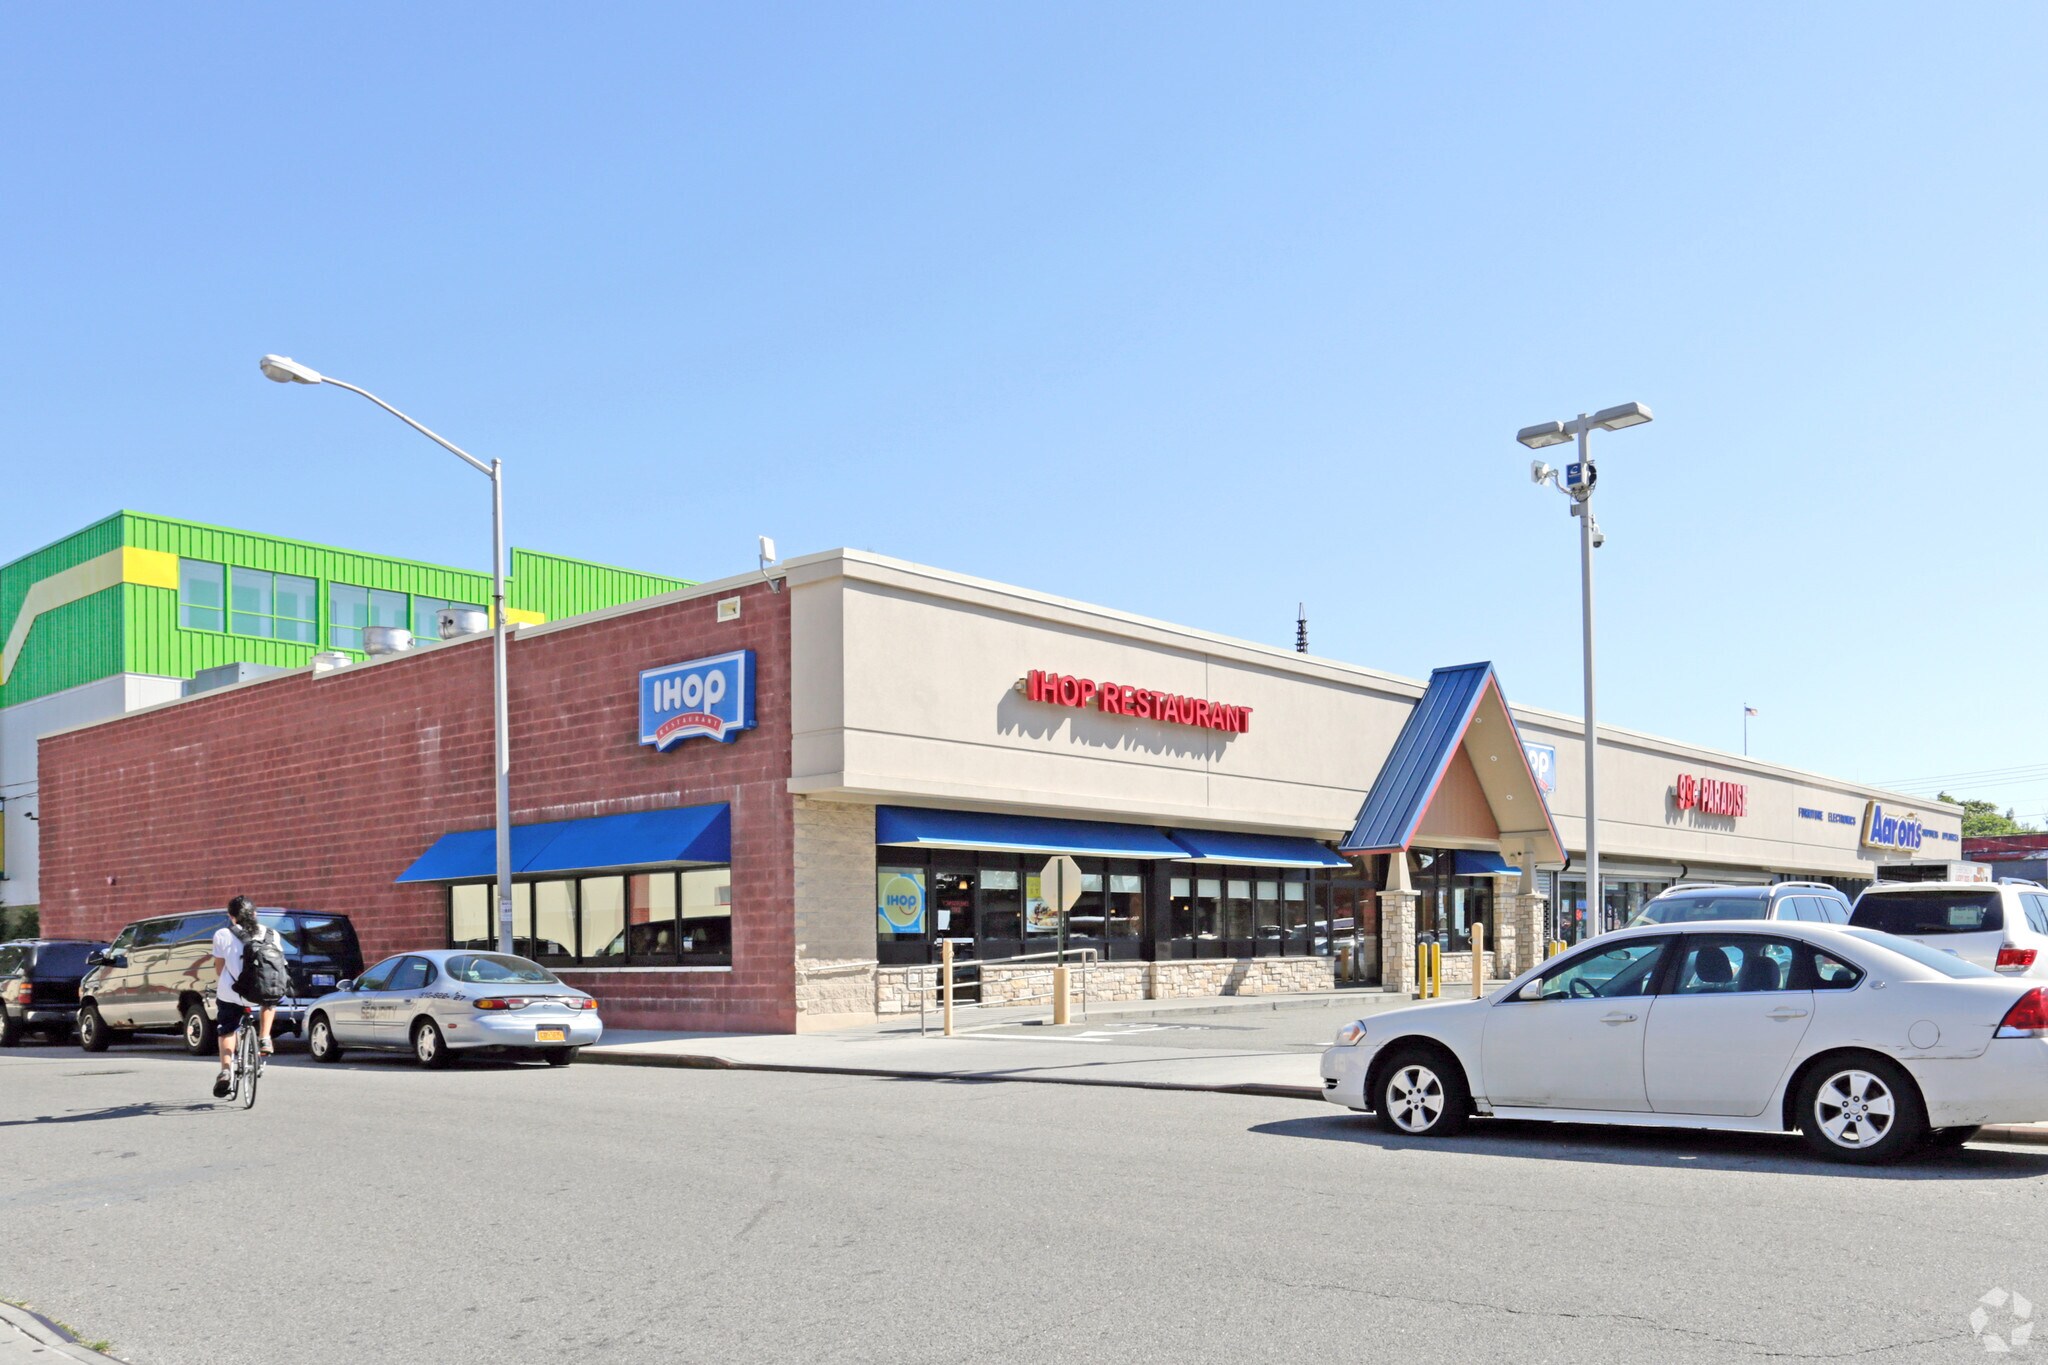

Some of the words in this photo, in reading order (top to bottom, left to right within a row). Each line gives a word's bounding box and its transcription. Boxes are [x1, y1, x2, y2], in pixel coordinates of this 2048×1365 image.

[653, 669, 726, 716] IHOP
[1027, 669, 1096, 708] IHOP
[1097, 682, 1253, 733] RESTAURANT
[1528, 749, 1549, 779] OP
[1699, 777, 1748, 817] PARADISE
[1828, 812, 1856, 826] ELECTRONICS
[1869, 804, 1922, 849] Aaron's
[886, 894, 917, 910] IHOP
